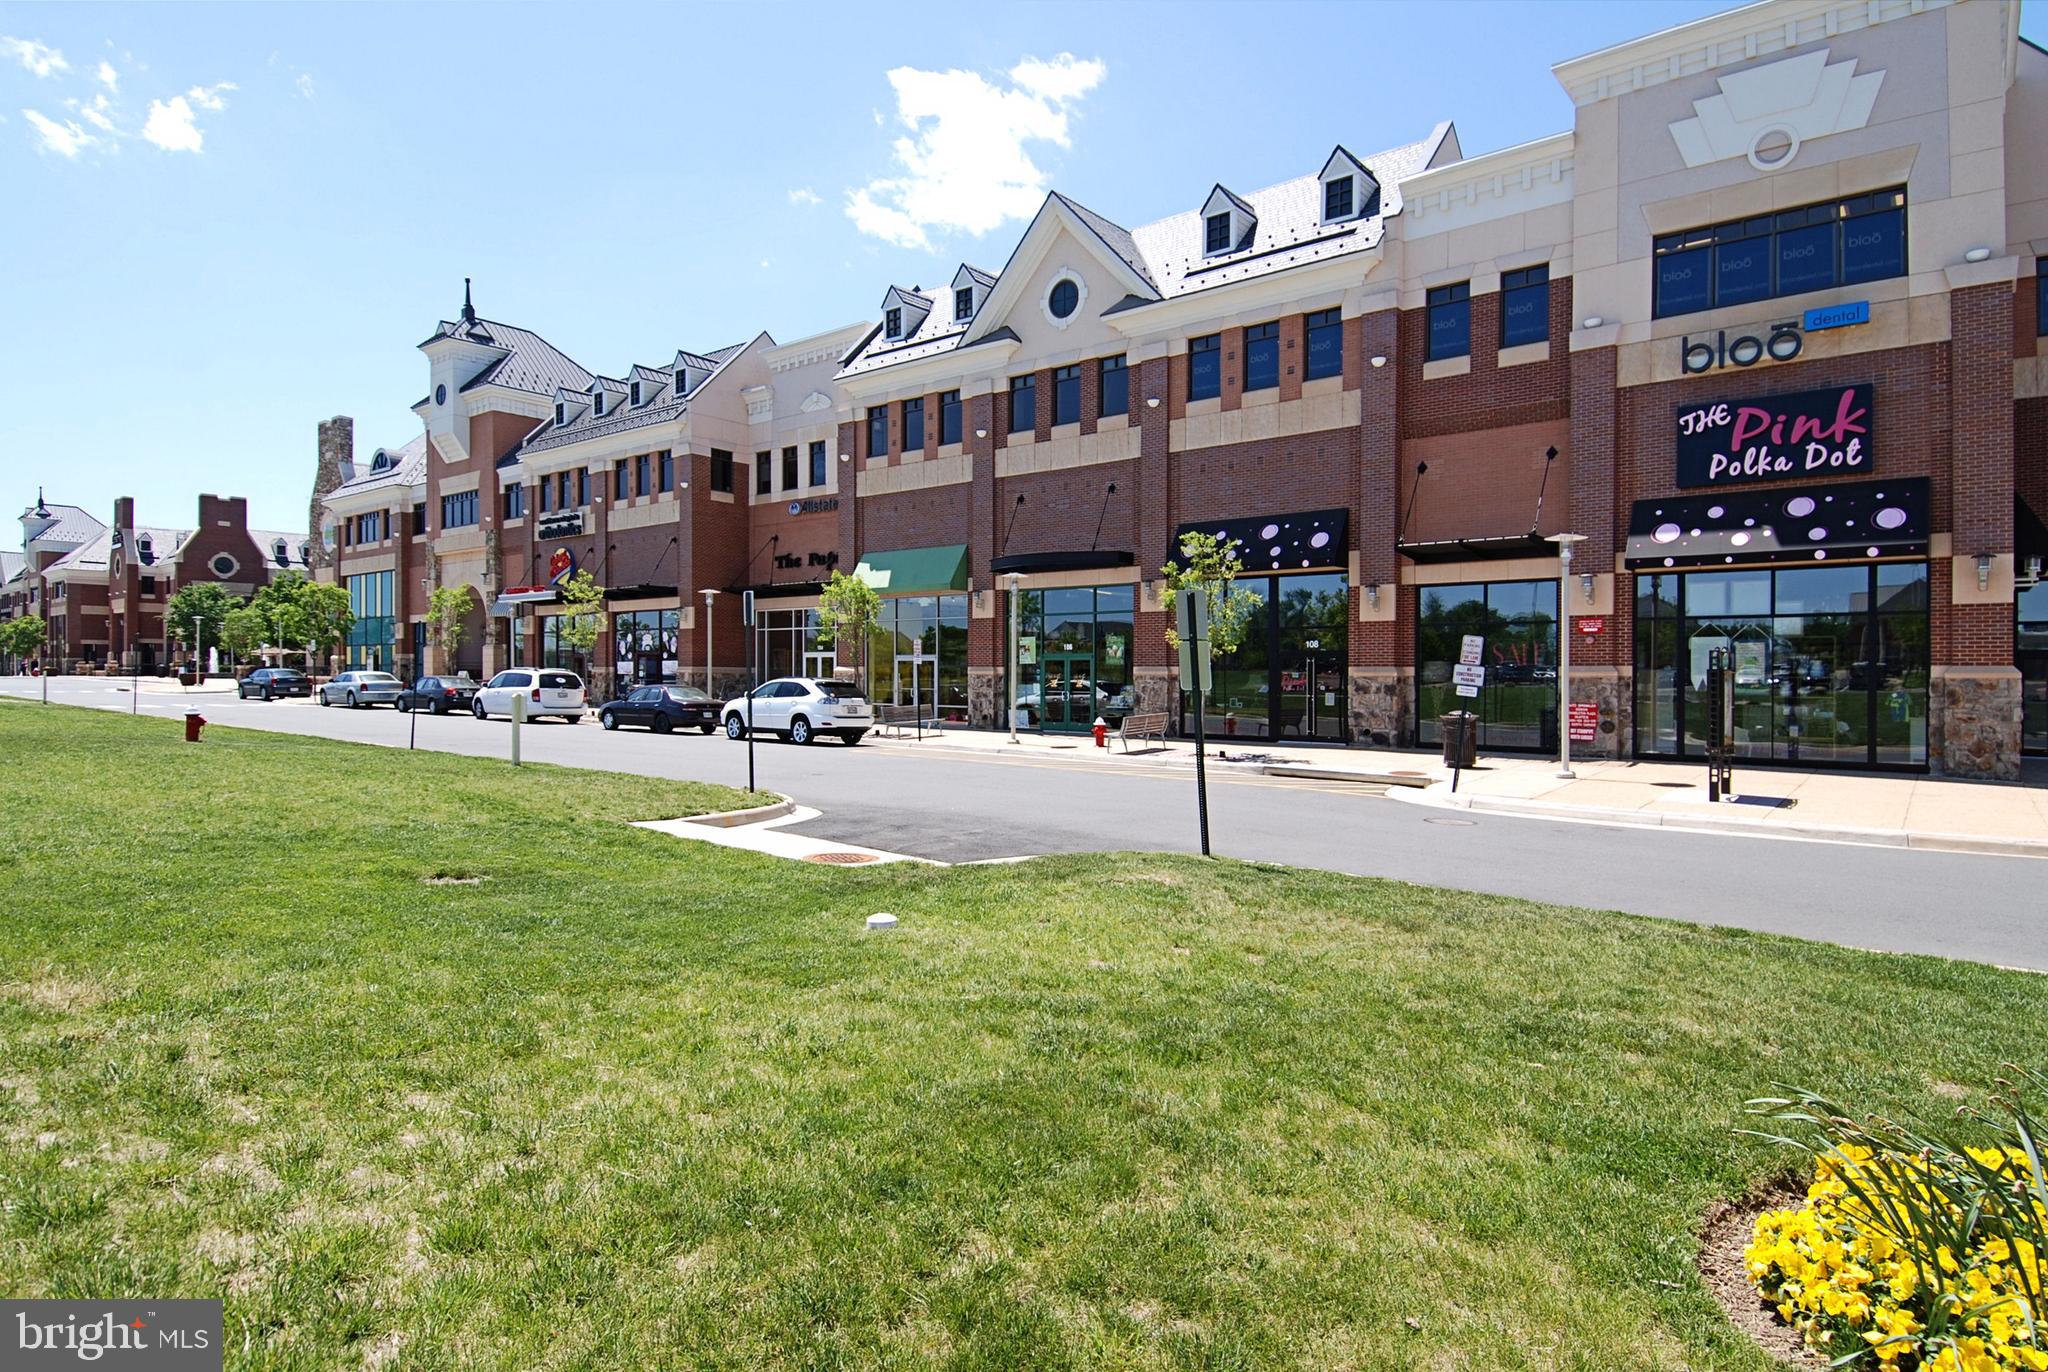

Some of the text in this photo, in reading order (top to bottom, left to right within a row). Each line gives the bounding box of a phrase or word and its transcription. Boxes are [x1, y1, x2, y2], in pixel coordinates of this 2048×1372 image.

[1812, 306, 1861, 327] dental
[1679, 389, 1866, 451] THE Pink
[1709, 437, 1863, 479] Polka Dot
[775, 553, 801, 569] The
[1306, 640, 1319, 648] 108
